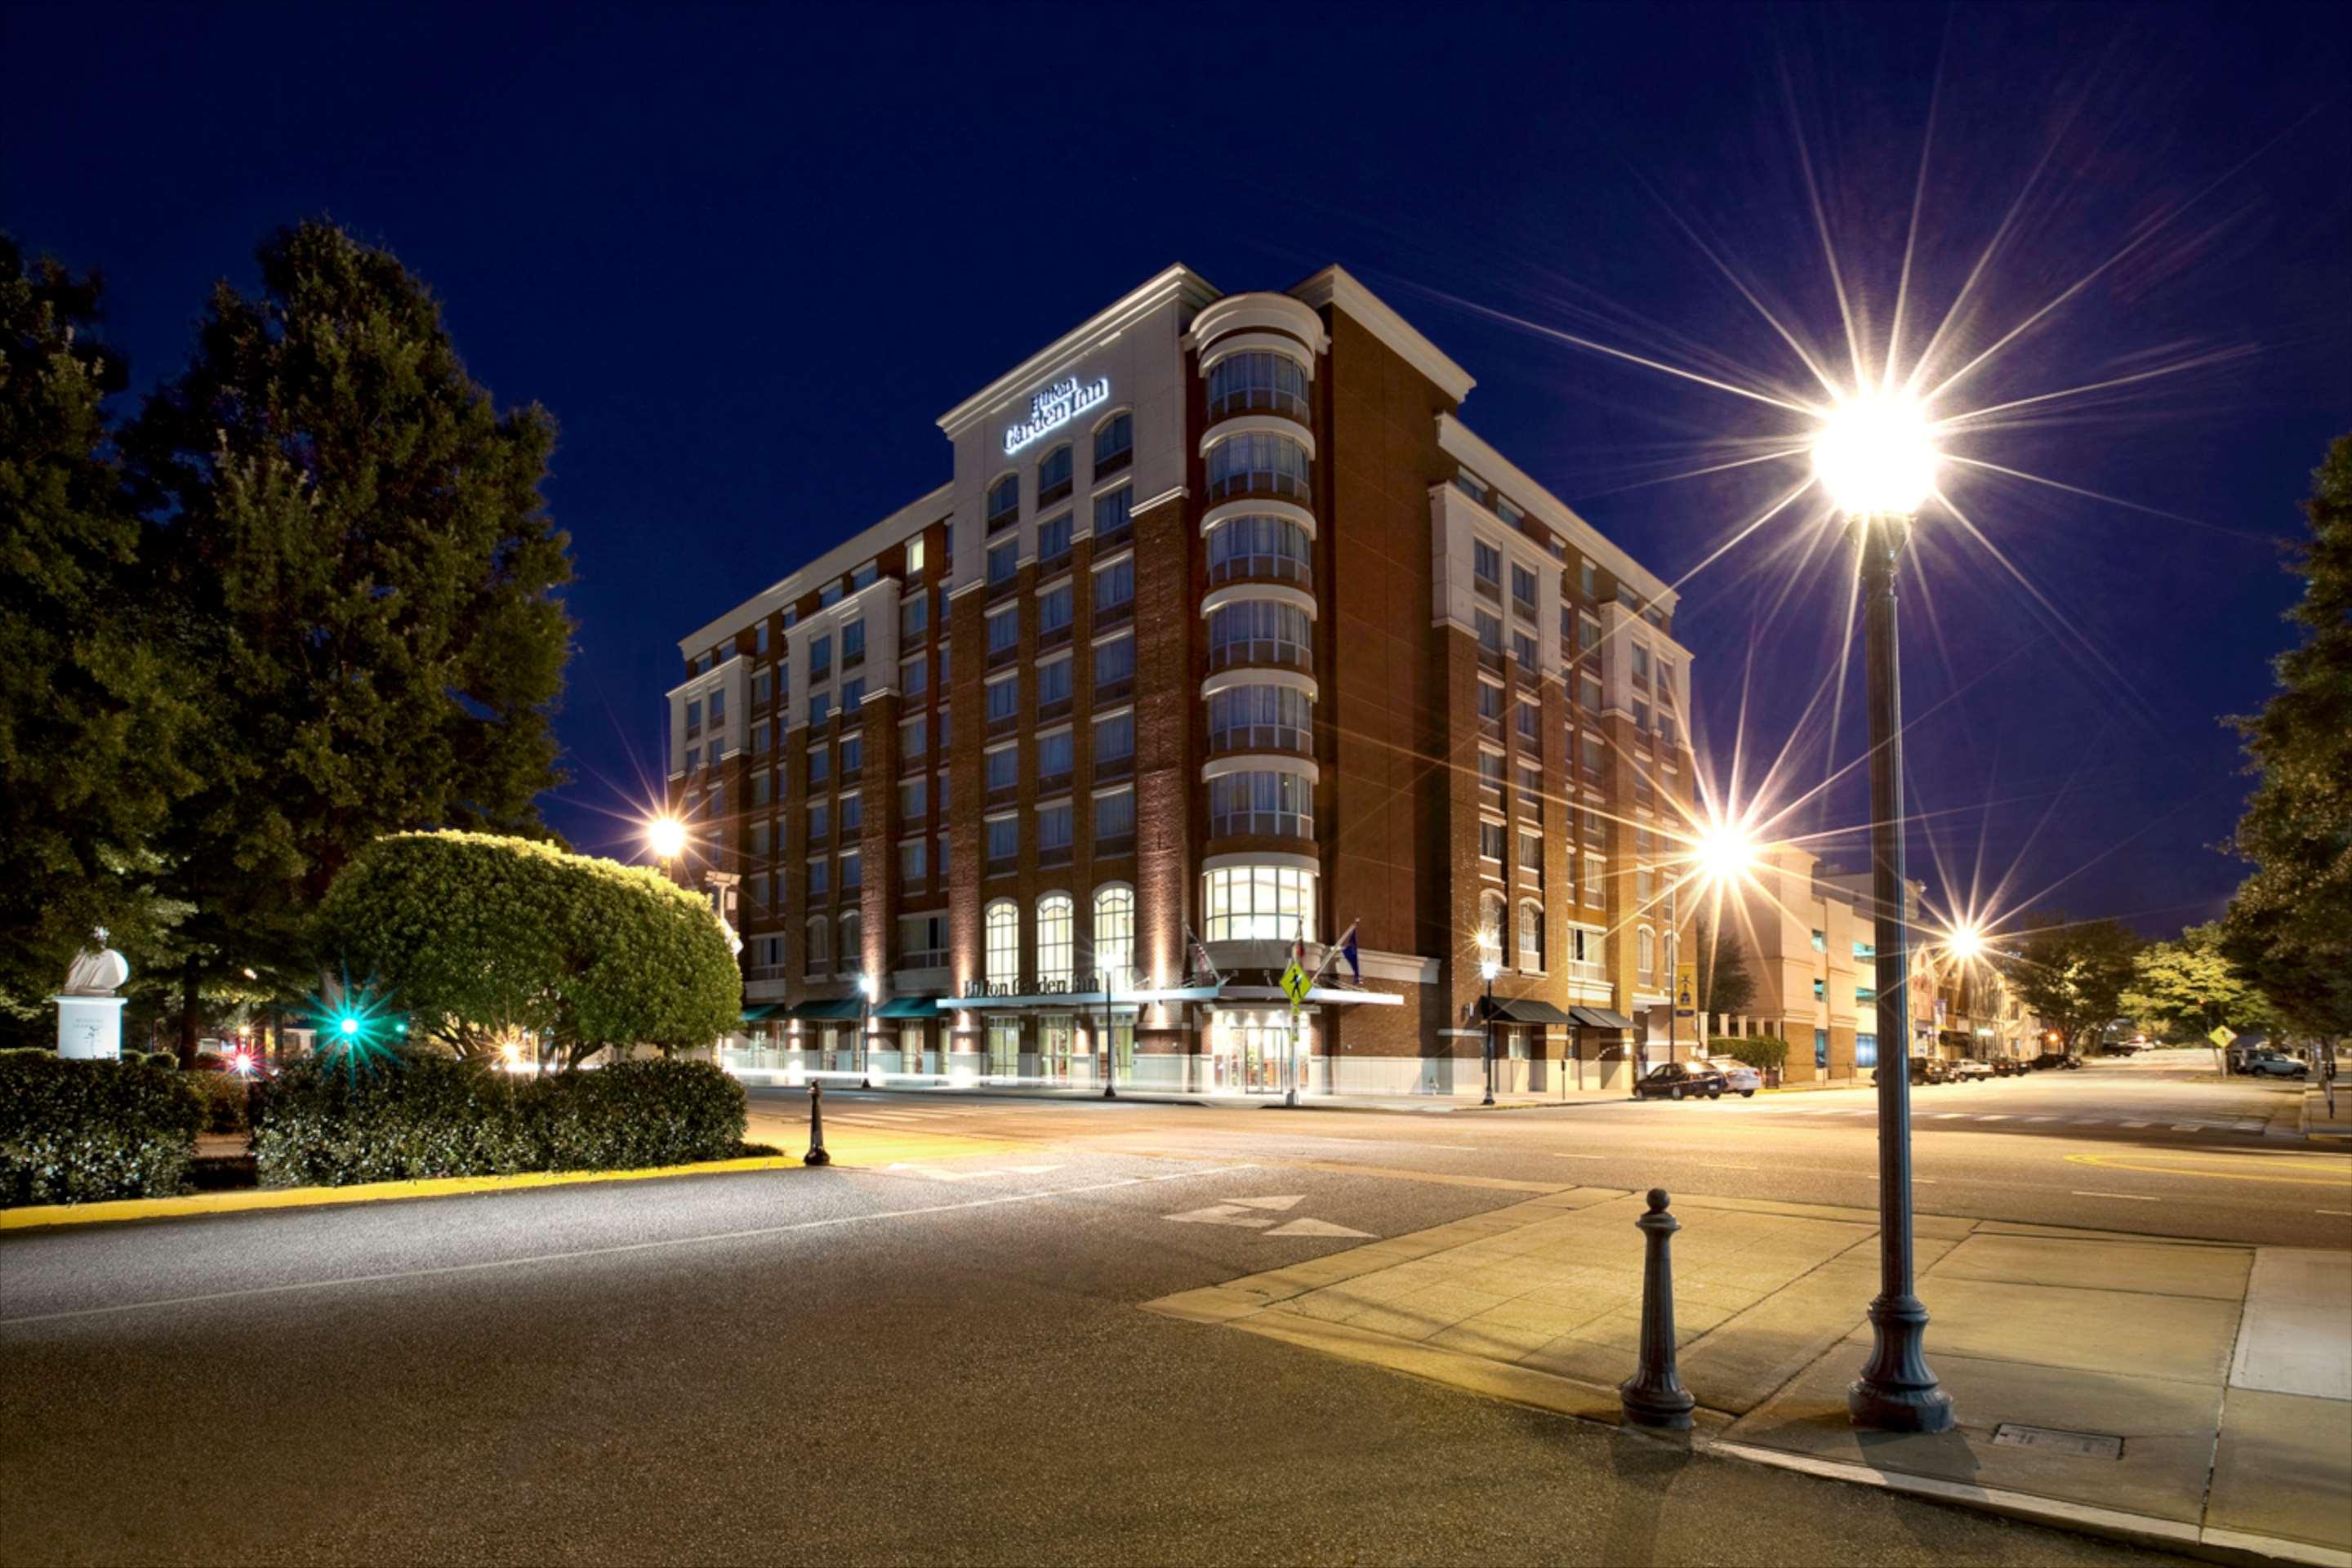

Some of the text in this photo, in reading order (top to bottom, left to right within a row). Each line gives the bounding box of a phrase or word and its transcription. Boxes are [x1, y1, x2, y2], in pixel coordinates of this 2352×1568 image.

[1031, 377, 1076, 415] Hilton
[1004, 378, 1108, 454] Garden Inn
[964, 978, 1008, 997] Hilton
[1071, 974, 1100, 993] Inn
